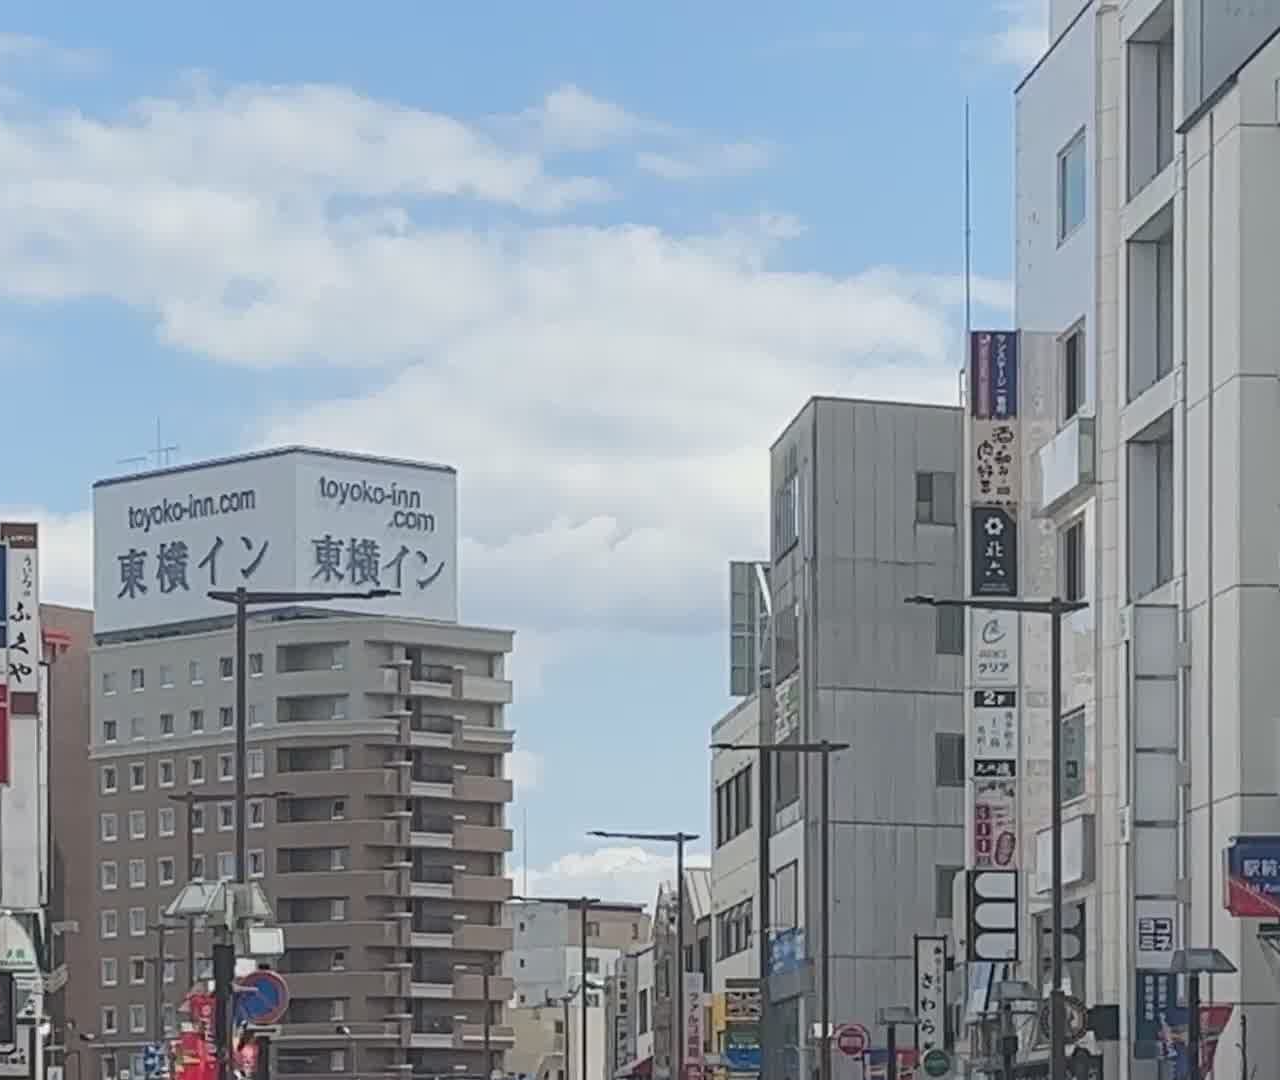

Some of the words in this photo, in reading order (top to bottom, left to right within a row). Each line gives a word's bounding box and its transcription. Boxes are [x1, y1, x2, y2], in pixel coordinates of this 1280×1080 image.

[127, 488, 256, 533] toyoko-inn.com
[319, 475, 421, 509] toyoko-inn
[388, 508, 435, 533] .com
[117, 535, 270, 600] 東横イン
[311, 534, 446, 591] 東横イン
